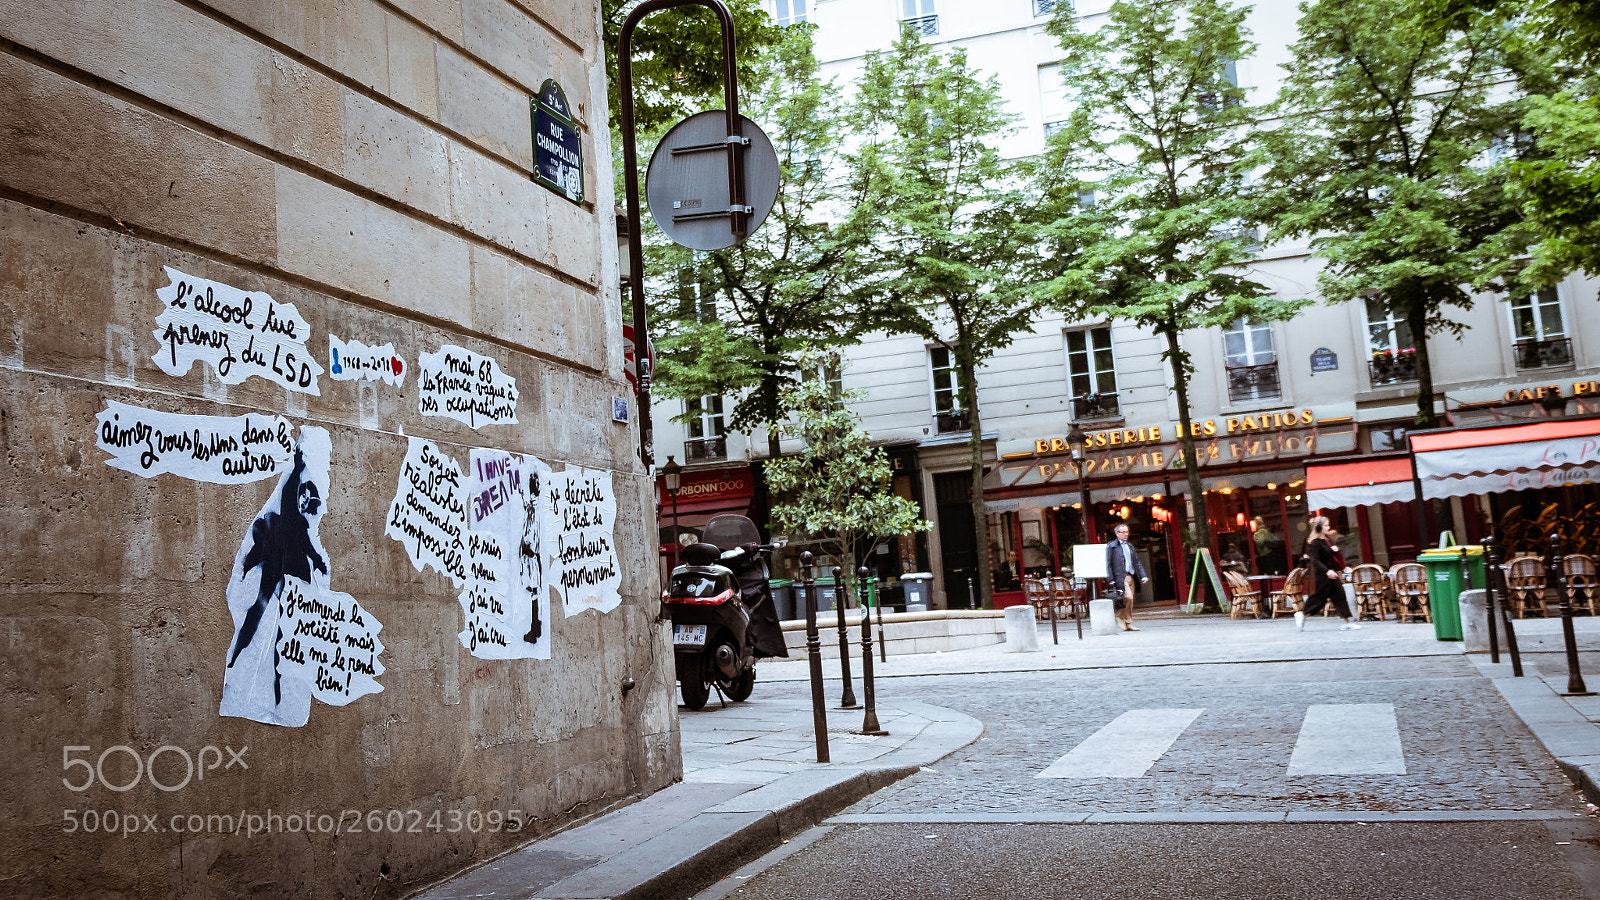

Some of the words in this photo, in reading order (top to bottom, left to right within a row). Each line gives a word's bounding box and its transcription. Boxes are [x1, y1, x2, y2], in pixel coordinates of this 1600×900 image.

[550, 122, 563, 141] RUE
[536, 132, 580, 168] CHAMPOLLION
[170, 281, 254, 329] l'alcool
[262, 303, 296, 339] tue
[163, 323, 236, 376] prenez
[241, 335, 266, 367] du
[272, 344, 312, 388] LSD
[445, 353, 475, 376] mai
[478, 360, 492, 384] 68
[423, 369, 435, 391] la
[508, 384, 515, 402] à
[1573, 381, 1600, 395] PI
[422, 396, 438, 412] ses
[1226, 409, 1313, 432] PATIOS
[101, 413, 159, 469] aimez
[155, 430, 192, 454] vous
[192, 429, 209, 462] les
[241, 417, 275, 446] dans
[223, 447, 276, 476] autres
[477, 457, 484, 482] I
[485, 457, 511, 481] HAVE
[404, 461, 465, 522] réalistes
[406, 487, 465, 550] demandez
[563, 505, 590, 532] l'état
[593, 506, 603, 525] de
[391, 502, 466, 581] l'impossible
[480, 539, 502, 560] suis
[558, 532, 610, 565] bonheur
[471, 562, 496, 582] venu
[560, 556, 615, 605] permanent
[286, 581, 345, 622] j'emmerde
[350, 604, 364, 628] la
[469, 585, 488, 613] j'ai
[490, 595, 504, 615] vu
[294, 619, 340, 644] société
[345, 632, 375, 652] mais
[469, 617, 489, 651] j'ai
[490, 627, 507, 647] cru
[281, 638, 305, 665] elle
[309, 647, 328, 663] me
[331, 647, 345, 671] le
[348, 654, 375, 675] rend
